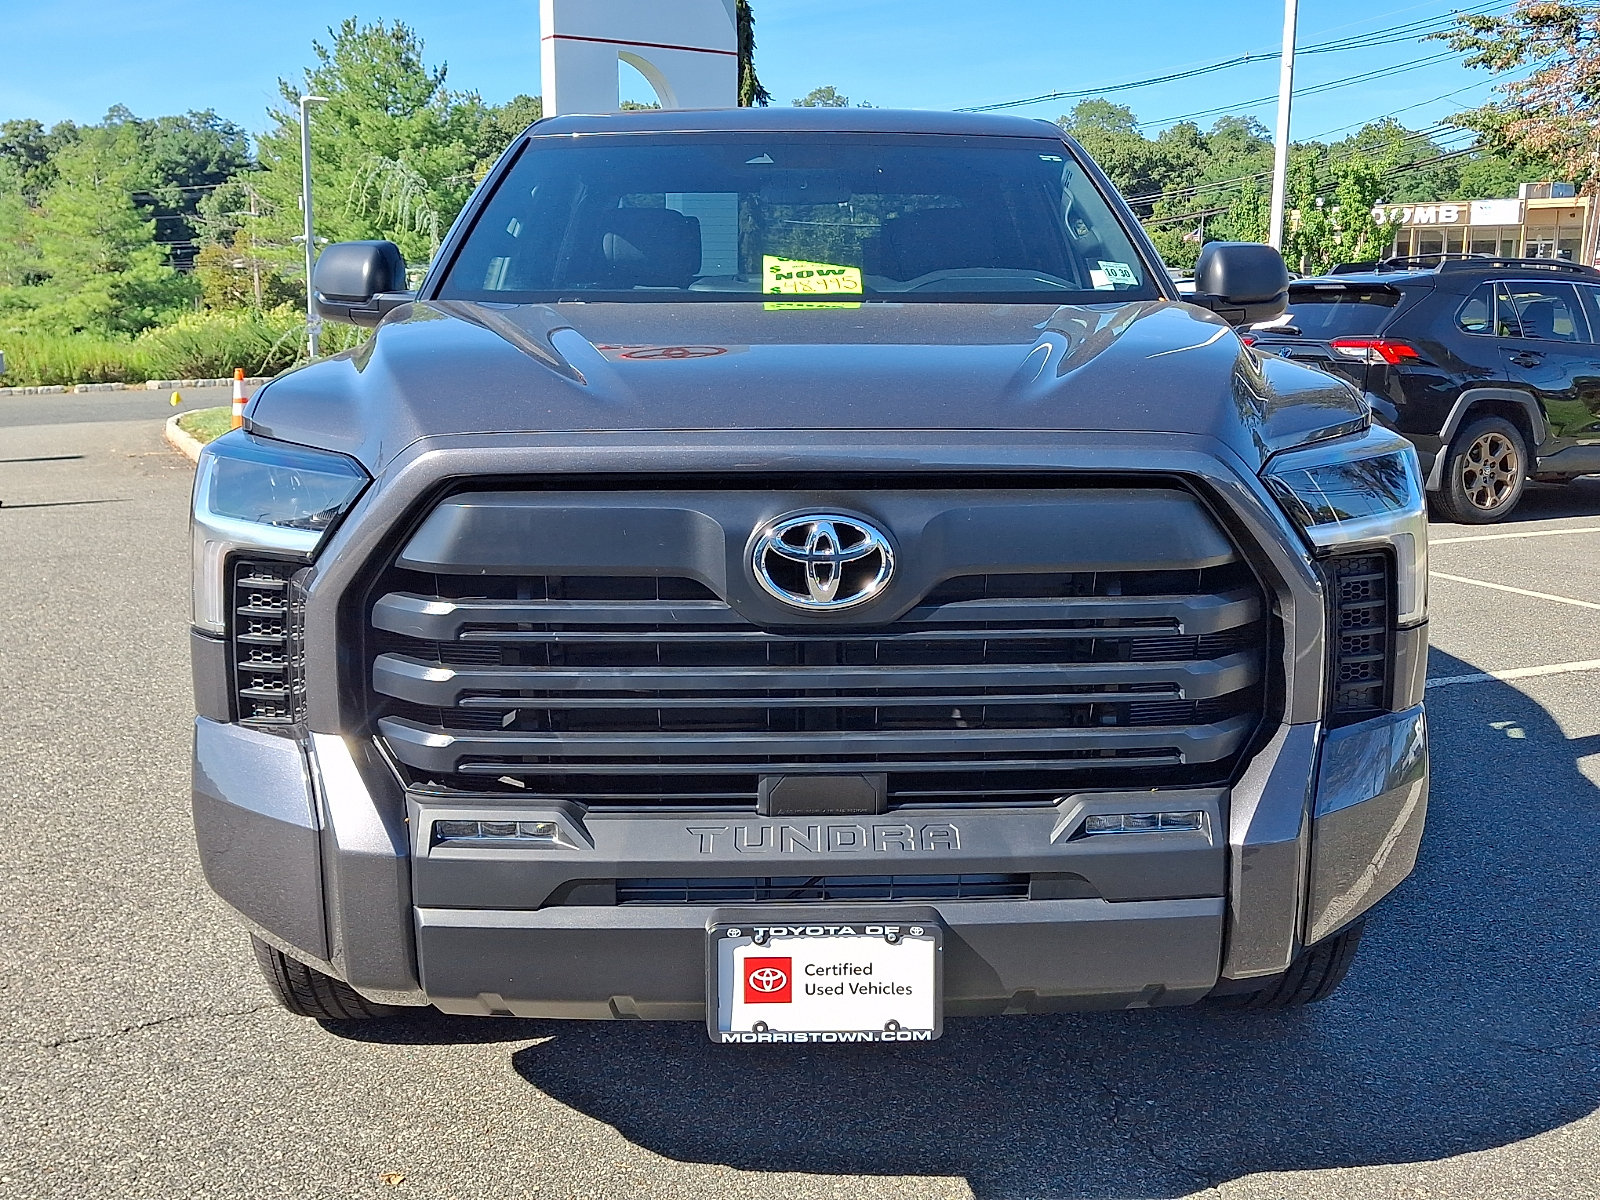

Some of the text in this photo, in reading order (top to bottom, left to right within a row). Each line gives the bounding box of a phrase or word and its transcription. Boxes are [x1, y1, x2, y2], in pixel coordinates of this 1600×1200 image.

[775, 269, 846, 280] NOW
[1104, 268, 1131, 277] 10 30
[685, 823, 961, 854] TUNDRA
[753, 925, 900, 936] TOYOTA OF
[804, 962, 873, 977] Certified
[804, 981, 913, 996] Used Vehicles
[721, 1030, 932, 1044] MORRISTOWN.COM
